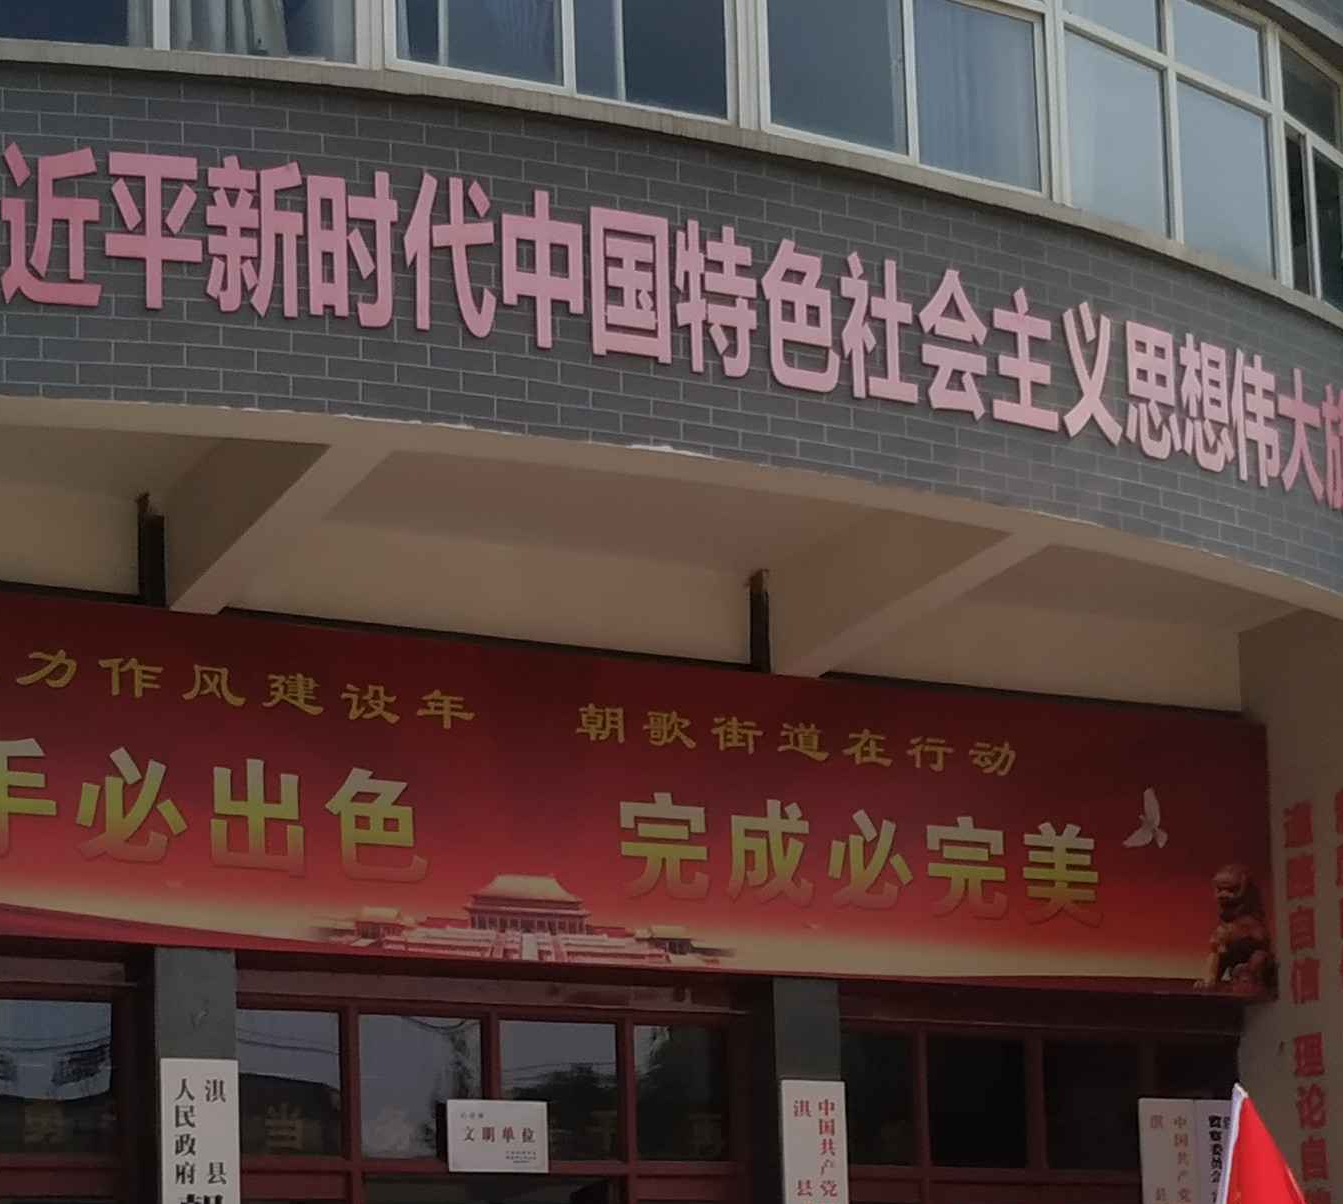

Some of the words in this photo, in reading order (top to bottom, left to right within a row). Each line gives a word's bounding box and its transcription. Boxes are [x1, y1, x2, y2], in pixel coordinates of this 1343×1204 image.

[575, 702, 1017, 777] 朝歌街道在行动
[618, 792, 1103, 928] 完成必完美
[175, 1078, 196, 1185] 人民政府
[463, 1125, 535, 1143] 文明单位
[818, 1098, 838, 1197] 中国共产党
